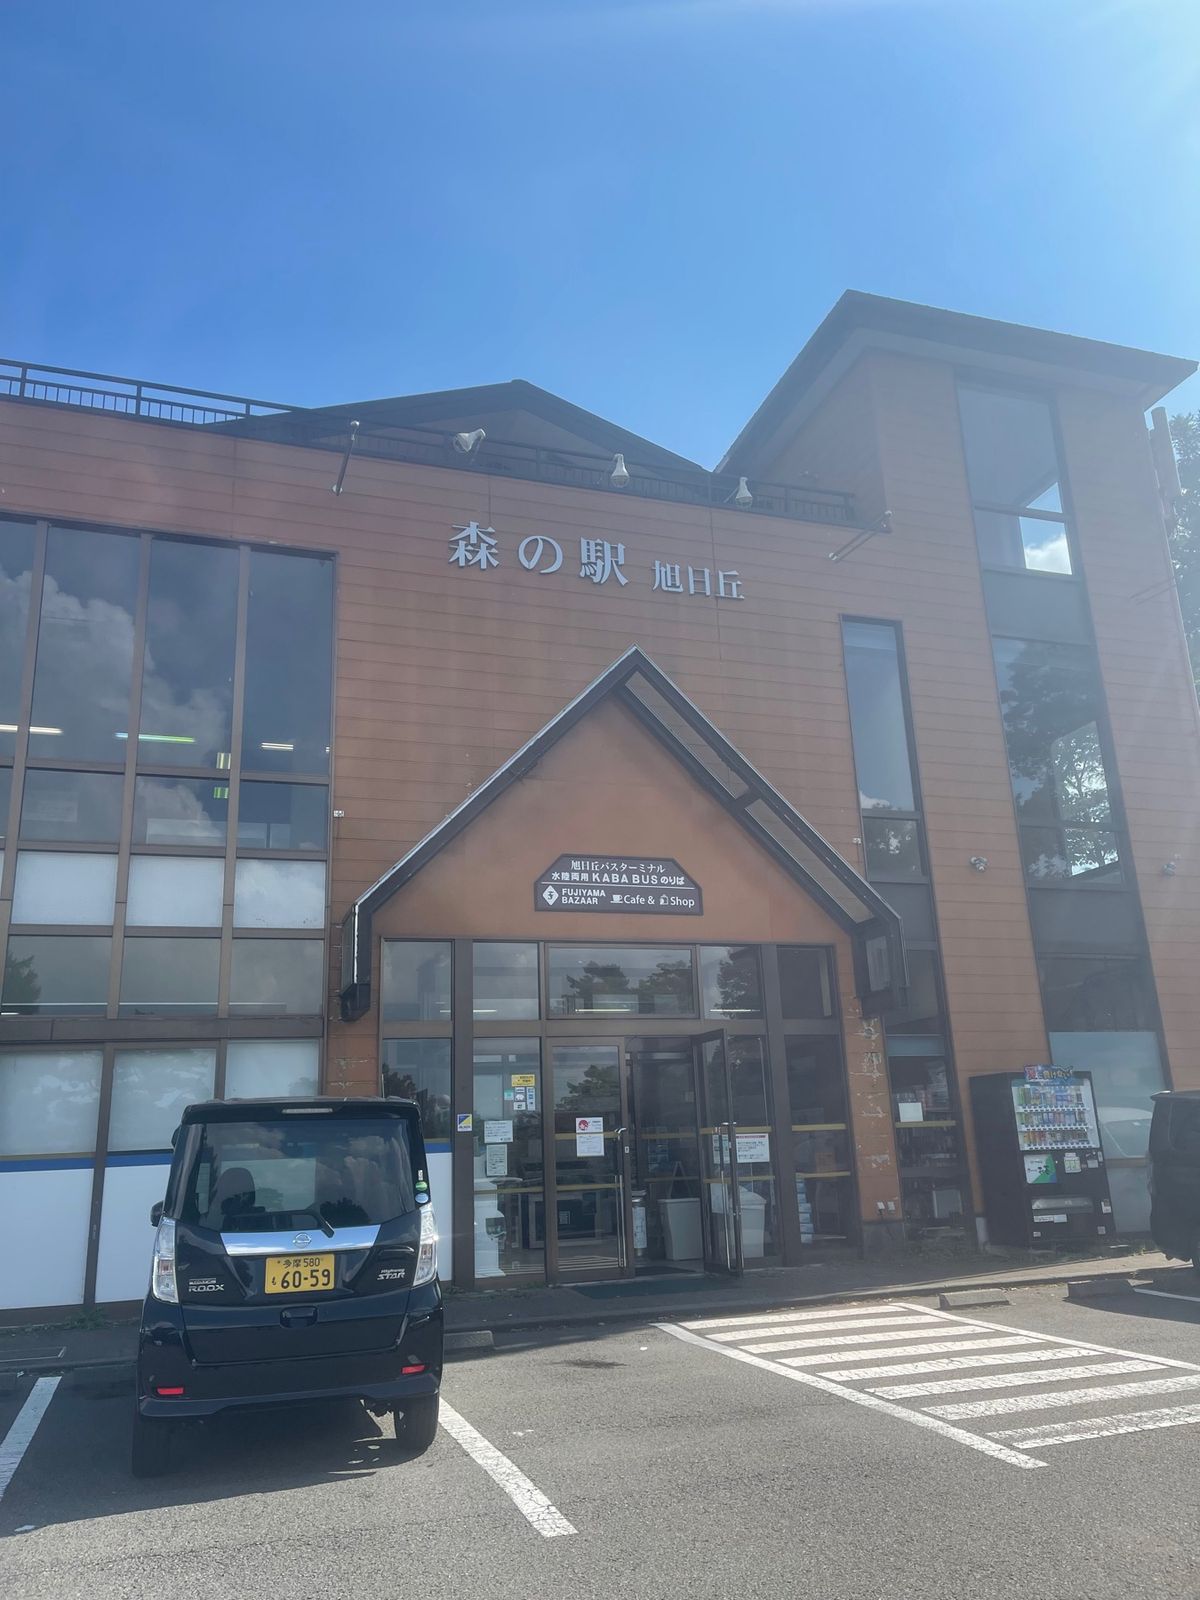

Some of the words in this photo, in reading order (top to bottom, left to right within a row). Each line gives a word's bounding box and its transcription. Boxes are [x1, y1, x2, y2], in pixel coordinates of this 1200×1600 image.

[449, 521, 629, 586] 森の駅
[651, 559, 745, 600] 旭日丘
[570, 860, 666, 874] 旭日丘バスターミナル
[551, 871, 589, 882] 水陸両用
[592, 872, 629, 884] KABA
[631, 874, 658, 885] BUS
[660, 875, 685, 886] のりば
[561, 888, 606, 897] FUJIYAMA
[561, 896, 599, 905] BAZAAR
[623, 894, 646, 905] Cafe
[647, 895, 656, 905] &
[670, 896, 696, 908] Shop
[283, 1258, 302, 1269] 多摩
[303, 1256, 321, 1268] 580
[280, 1268, 332, 1290] 60-59
[377, 1272, 406, 1281] STAR
[188, 1284, 225, 1293] ROOX
